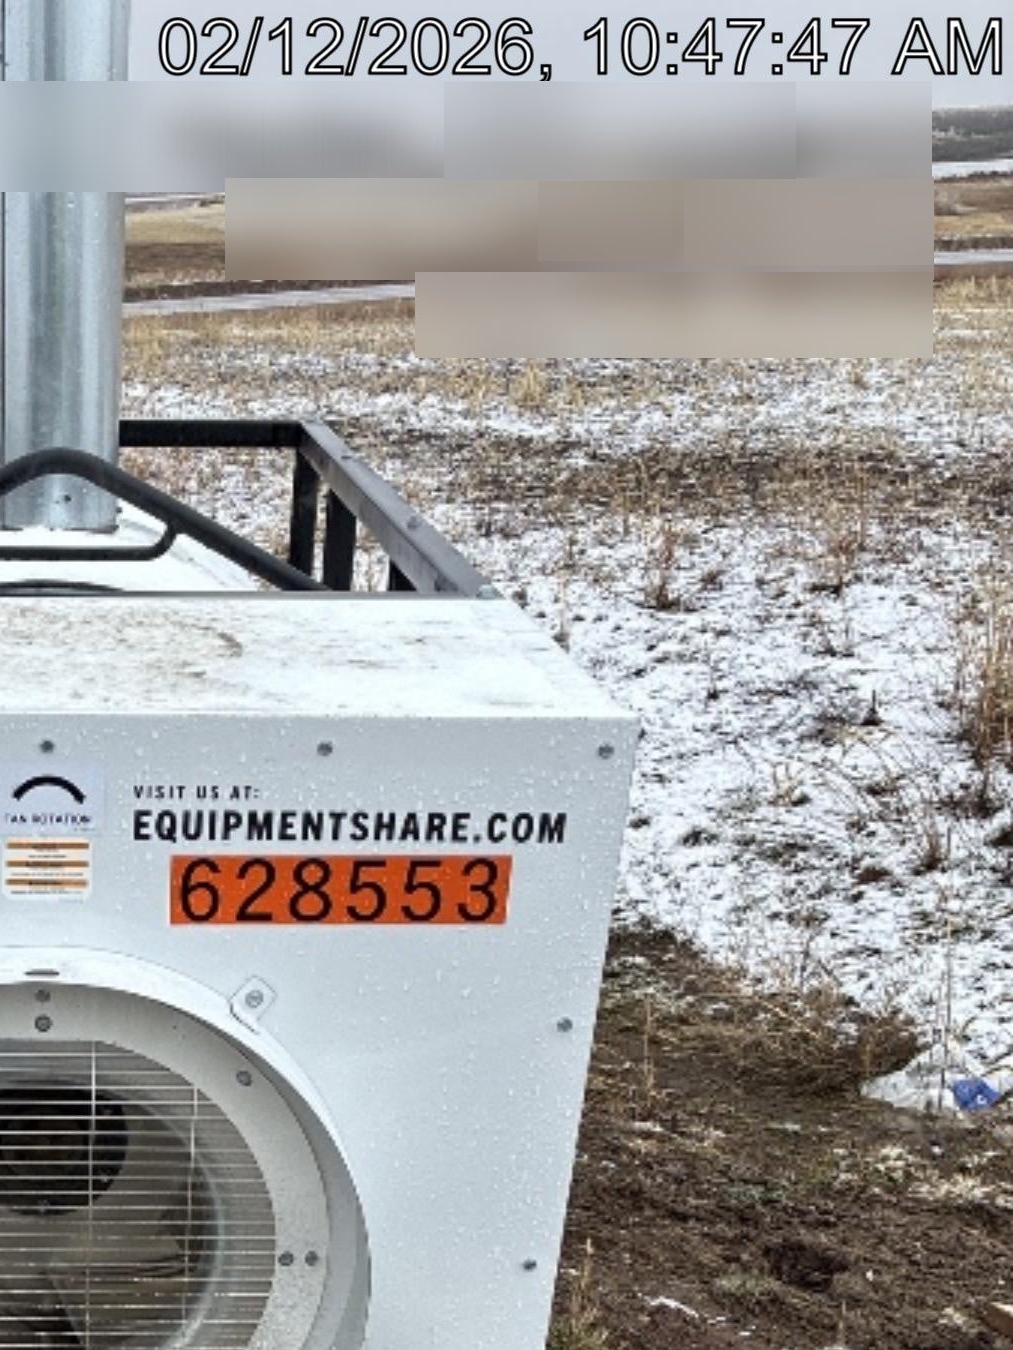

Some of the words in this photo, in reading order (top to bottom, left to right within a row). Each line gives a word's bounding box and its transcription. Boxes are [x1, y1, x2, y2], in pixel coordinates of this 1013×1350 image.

[132, 784, 186, 799] VISIT
[195, 784, 221, 800] US
[229, 785, 260, 800] AT:
[132, 809, 568, 844] EQUIPMENTSHARE.COM
[180, 857, 499, 922] 628553
